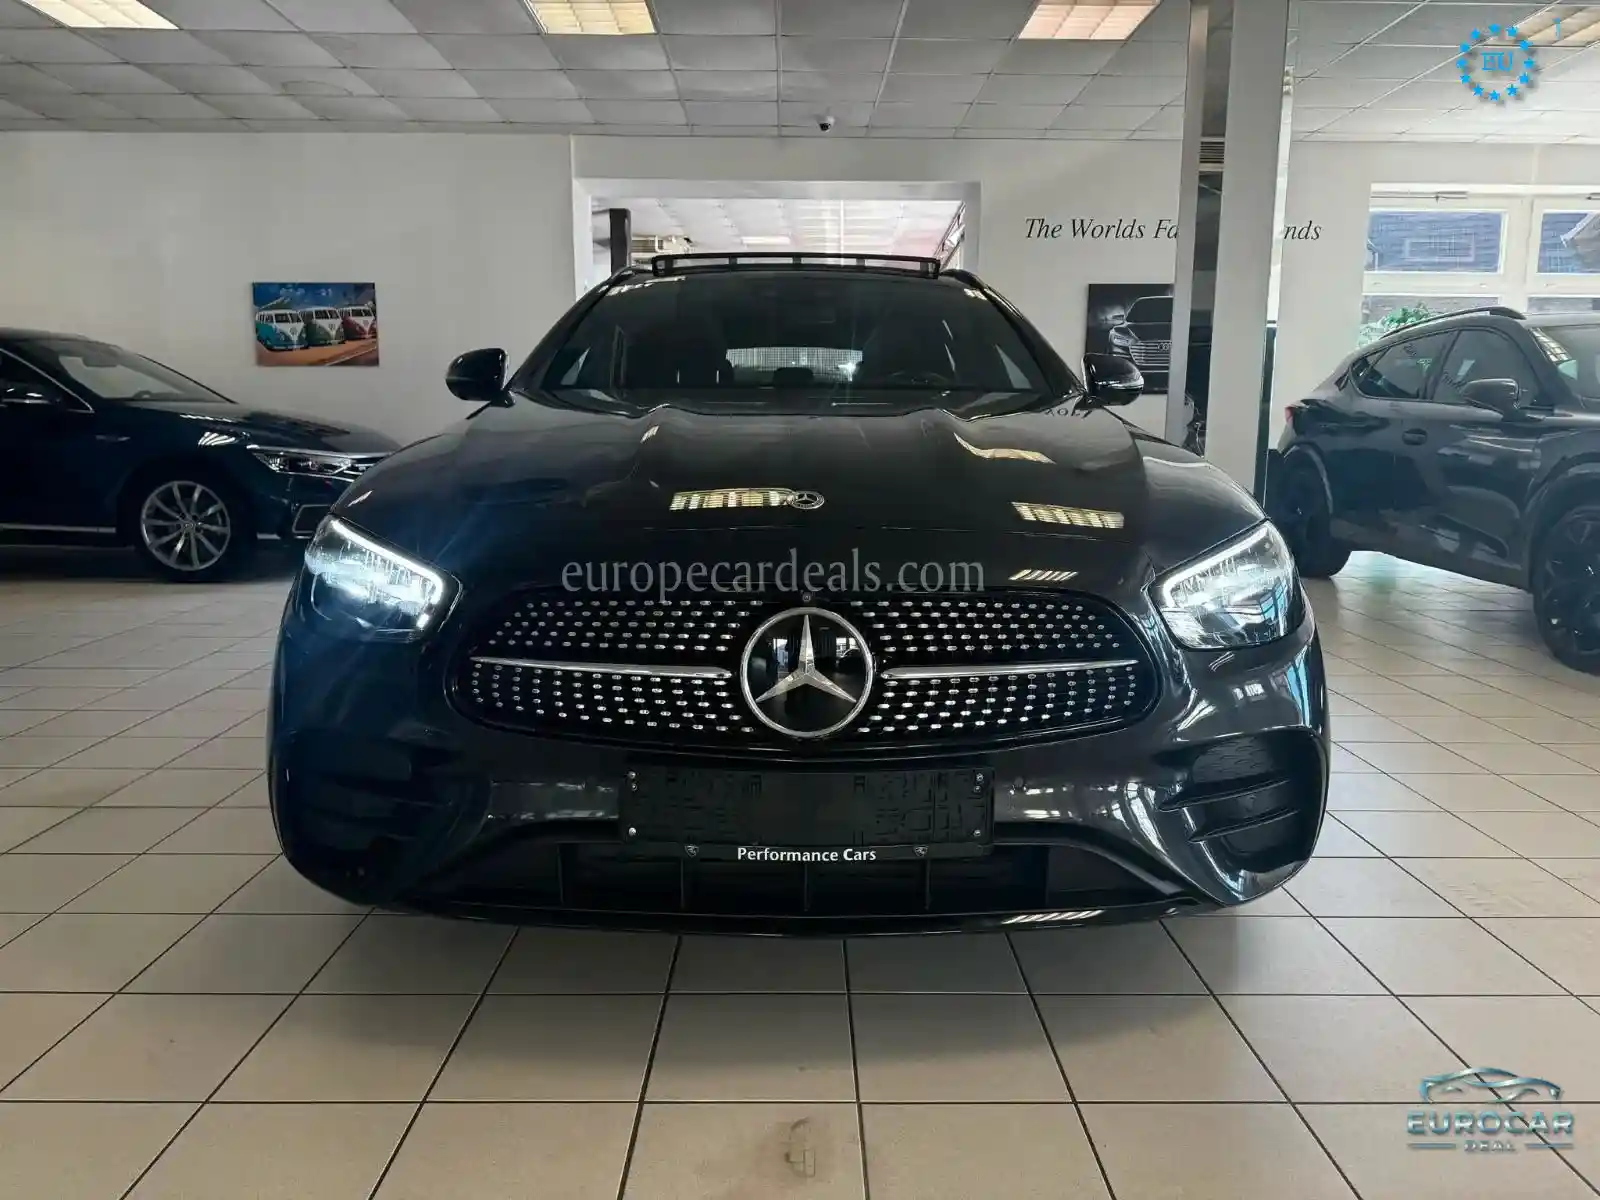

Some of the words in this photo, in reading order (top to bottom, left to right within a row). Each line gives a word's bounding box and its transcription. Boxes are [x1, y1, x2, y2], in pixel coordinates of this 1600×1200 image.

[1025, 218, 1062, 239] The
[1070, 218, 1146, 239] Worlds
[1152, 219, 1179, 239] Fa
[1283, 219, 1323, 240] nds
[737, 846, 839, 862] Performance
[843, 847, 877, 861] Cars
